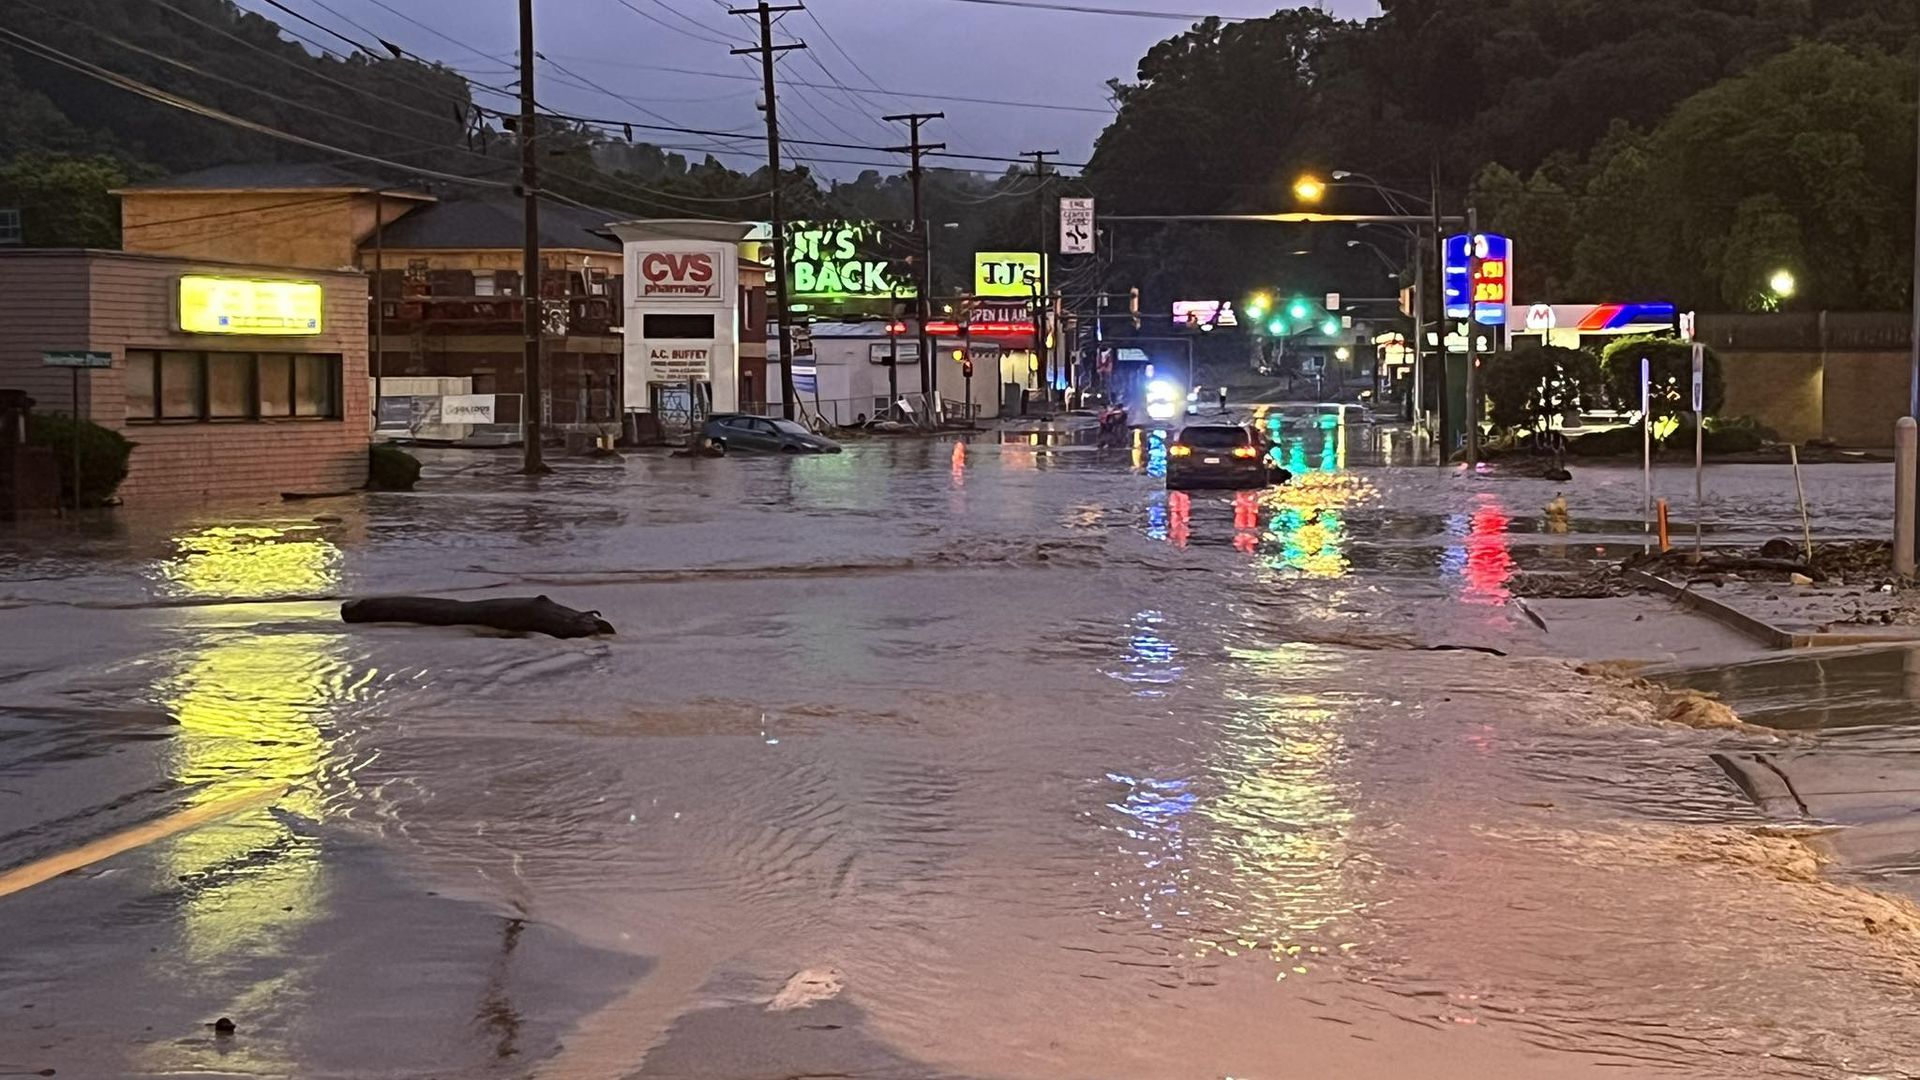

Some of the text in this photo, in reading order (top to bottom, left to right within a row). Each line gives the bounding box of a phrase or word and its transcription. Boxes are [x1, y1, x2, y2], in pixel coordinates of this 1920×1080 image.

[792, 230, 855, 262] IT'S
[643, 253, 712, 281] CVS
[795, 261, 890, 291] BACK
[980, 261, 1037, 286] TJ's
[645, 282, 713, 297] pharmacy
[651, 349, 707, 359] A.C. BUFFET
